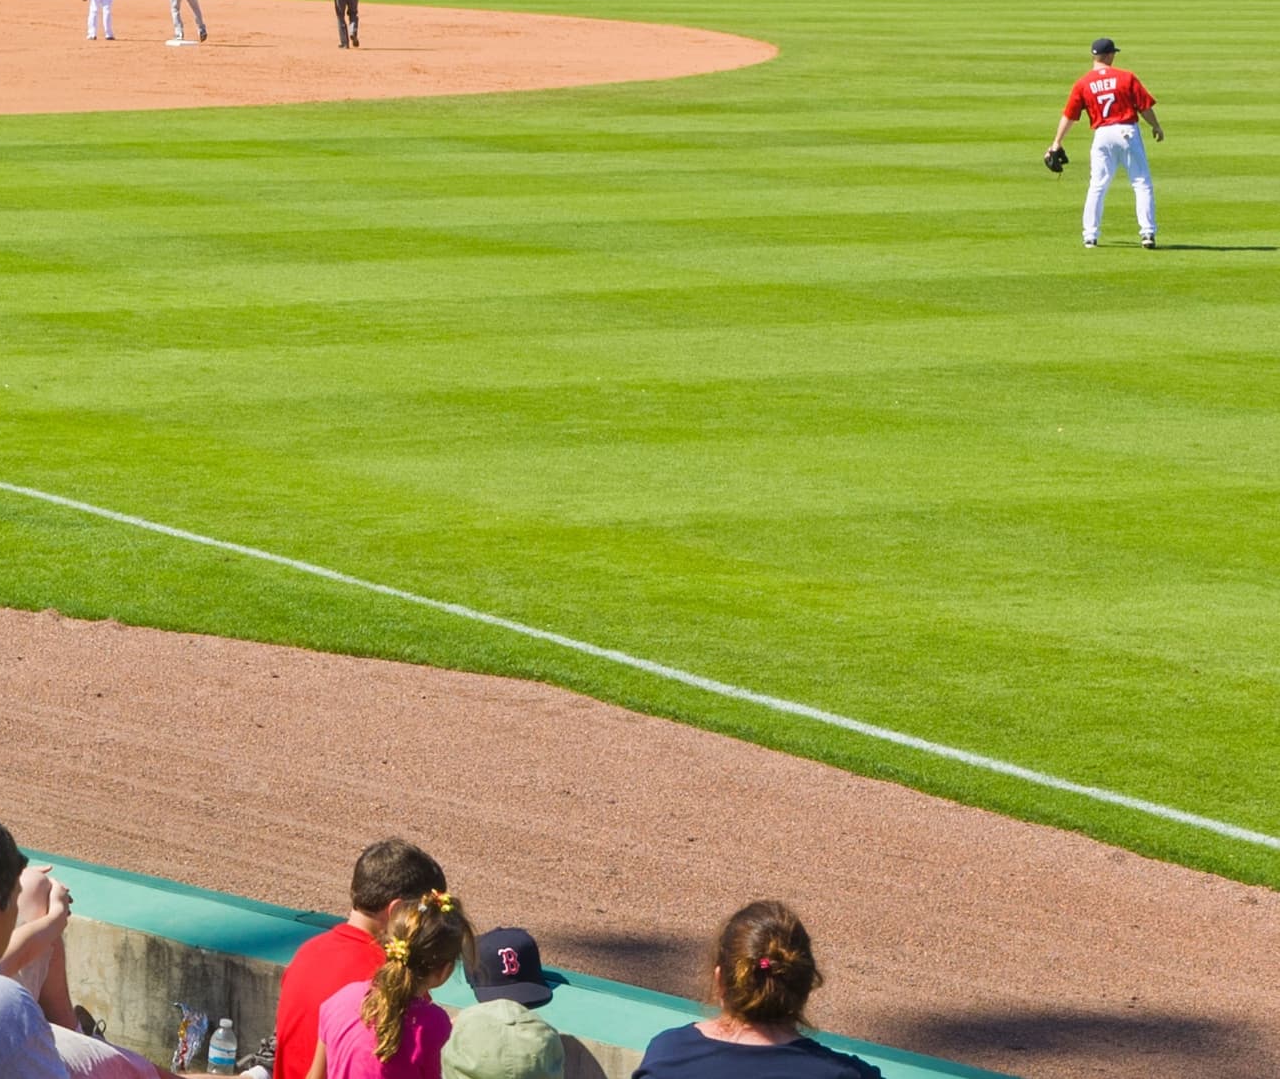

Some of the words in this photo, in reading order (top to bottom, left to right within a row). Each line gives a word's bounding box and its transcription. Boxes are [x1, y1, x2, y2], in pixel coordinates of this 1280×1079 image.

[1089, 77, 1117, 94] DREW
[1097, 93, 1115, 118] 7
[497, 947, 521, 976] B
